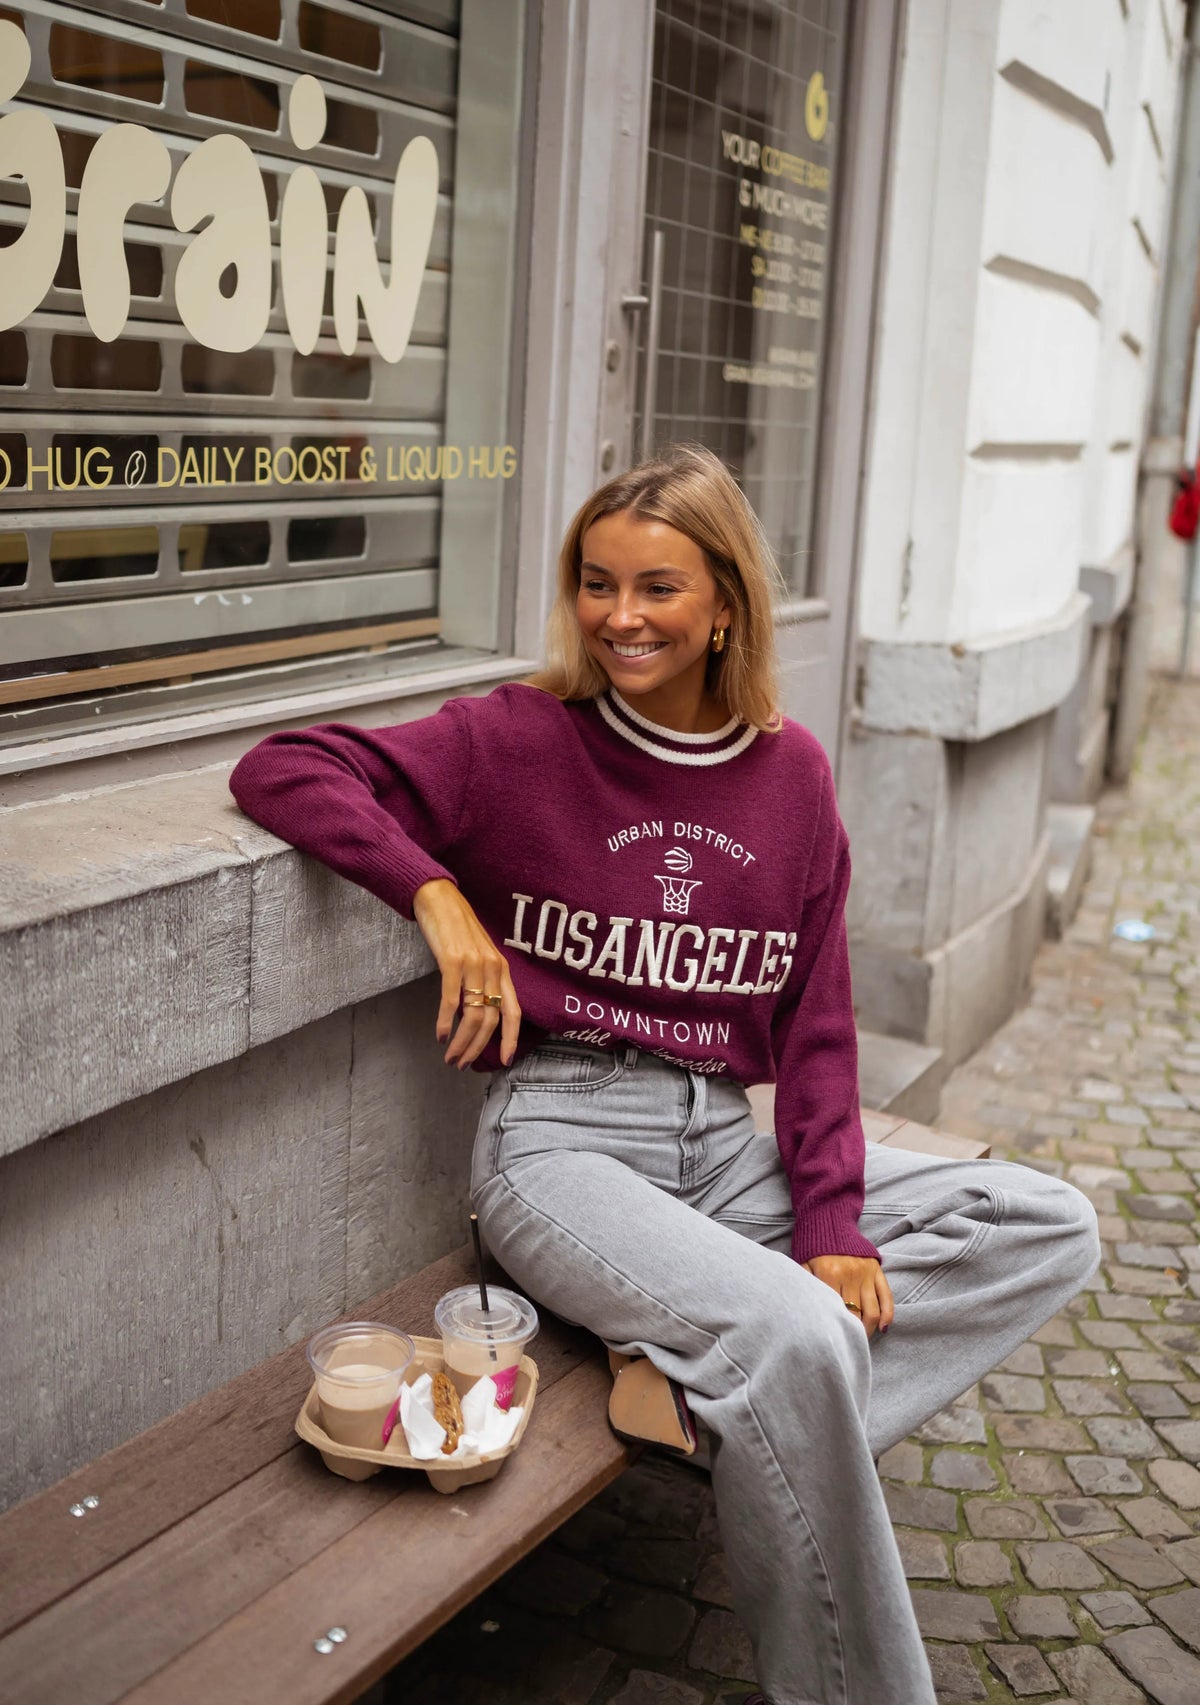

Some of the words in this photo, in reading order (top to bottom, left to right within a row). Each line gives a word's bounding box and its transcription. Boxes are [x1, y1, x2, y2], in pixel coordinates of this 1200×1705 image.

[722, 130, 761, 169] YOUR
[27, 447, 114, 491] HUG
[157, 447, 245, 488] DAILY
[254, 446, 351, 485] BOOST
[359, 446, 377, 482] &
[387, 446, 463, 482] LIQUID
[468, 445, 517, 479] HUG
[607, 820, 663, 853] URBAN
[674, 821, 756, 868] DISTRICT
[564, 994, 730, 1046] DOWNTOWN
